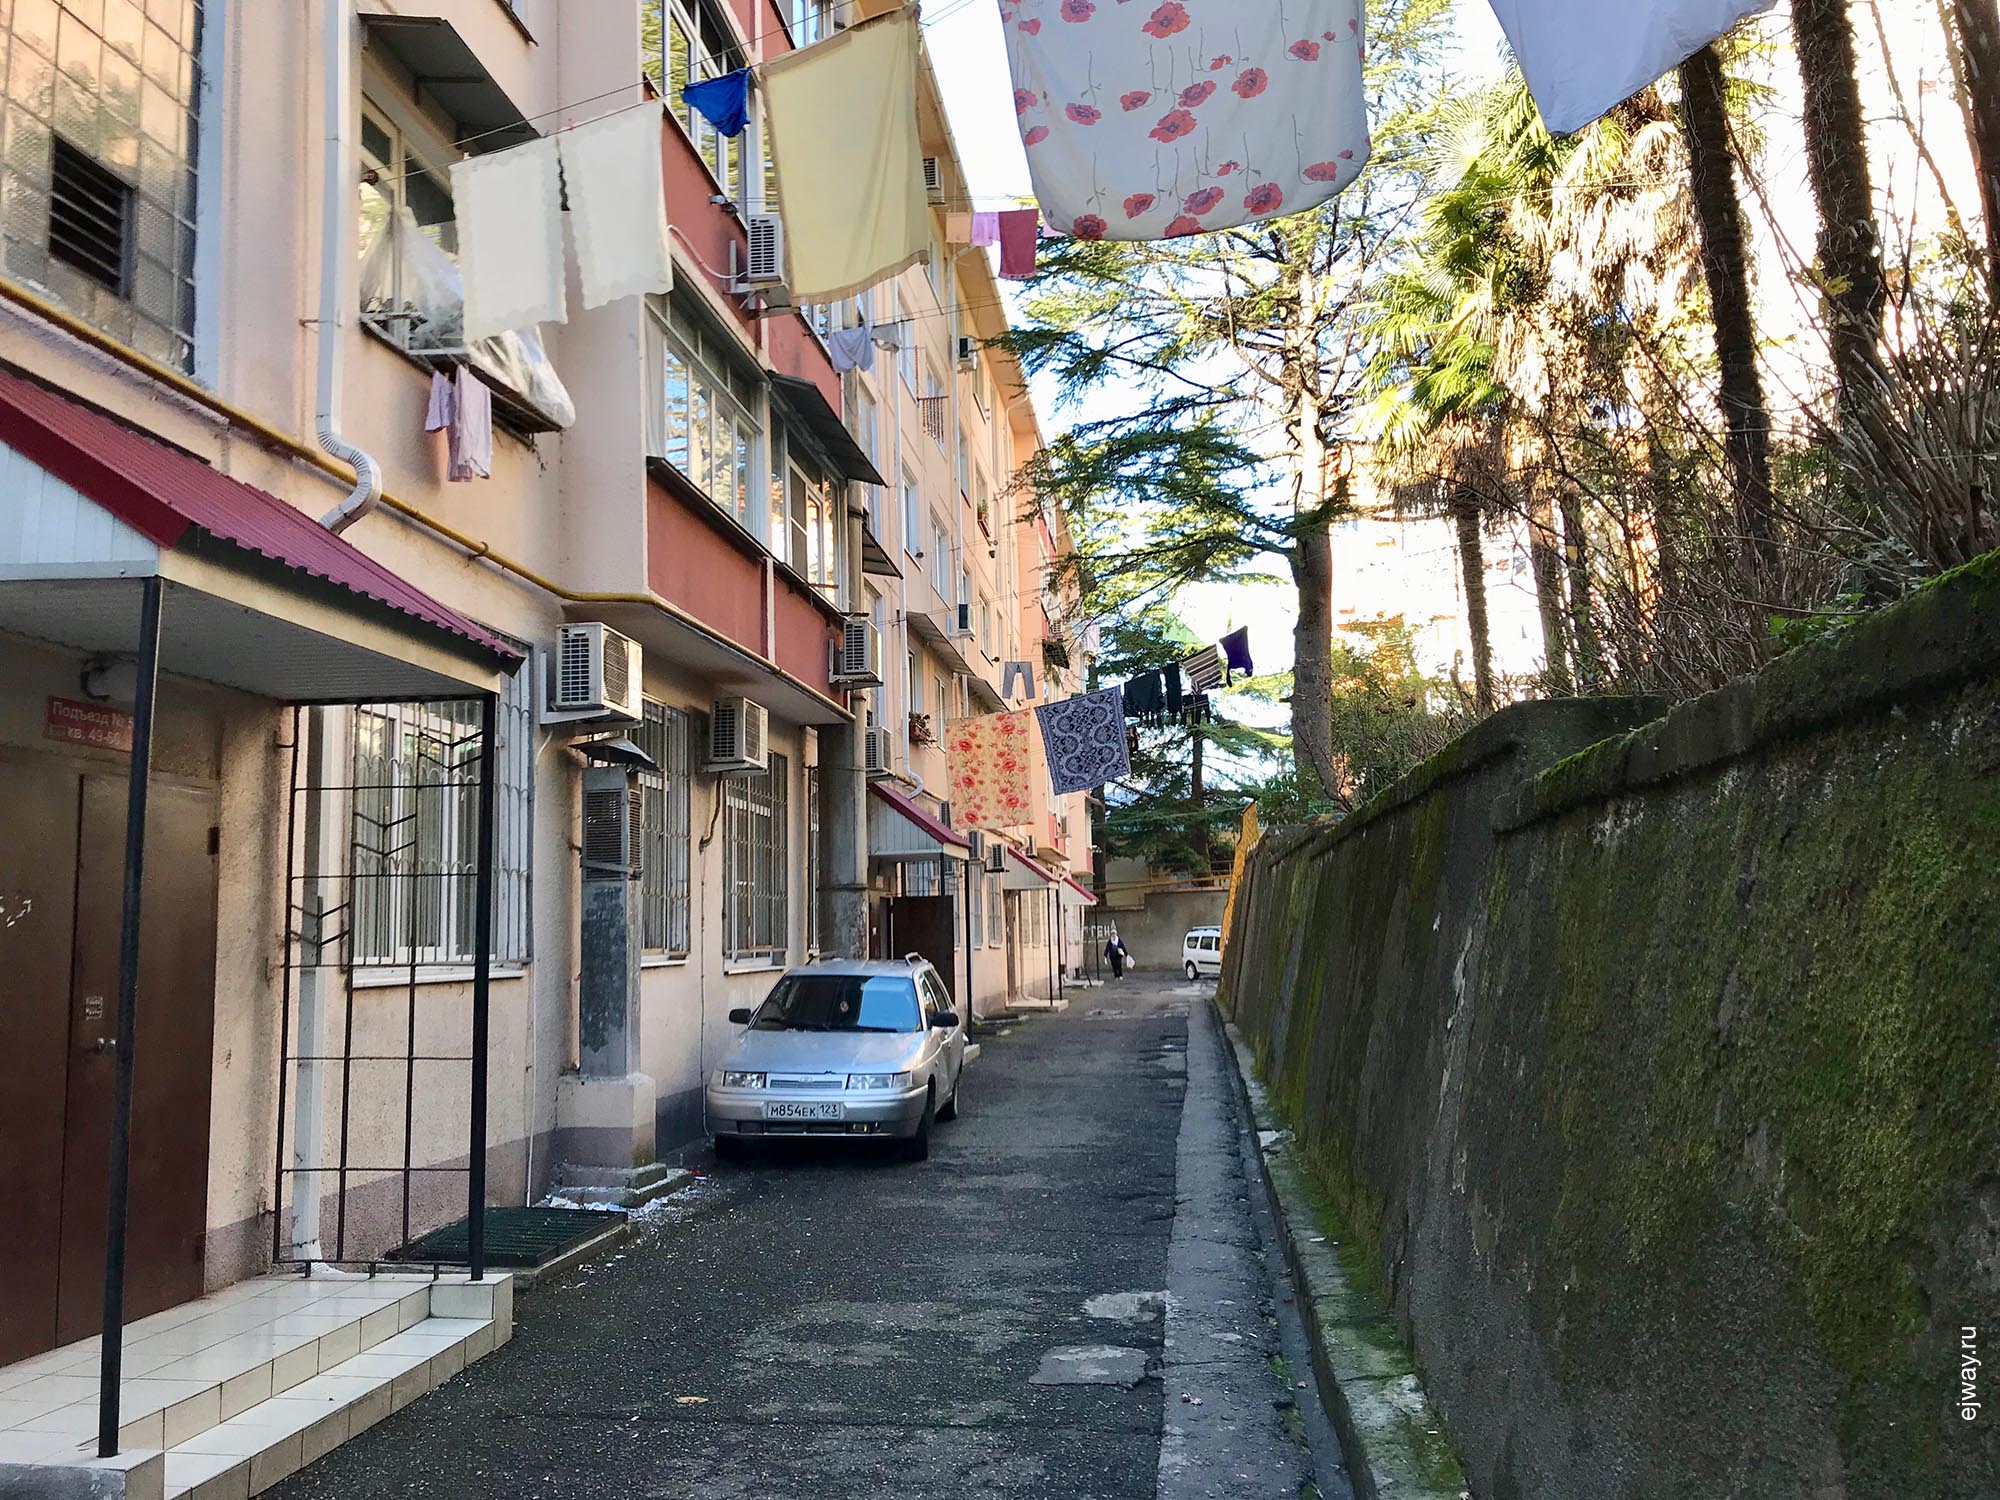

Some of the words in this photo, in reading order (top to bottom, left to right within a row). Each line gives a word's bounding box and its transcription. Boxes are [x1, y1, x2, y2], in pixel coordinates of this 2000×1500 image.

[52, 701, 109, 726] Подъезд
[770, 1104, 816, 1117] М854ЕК
[820, 1104, 838, 1114] 123
